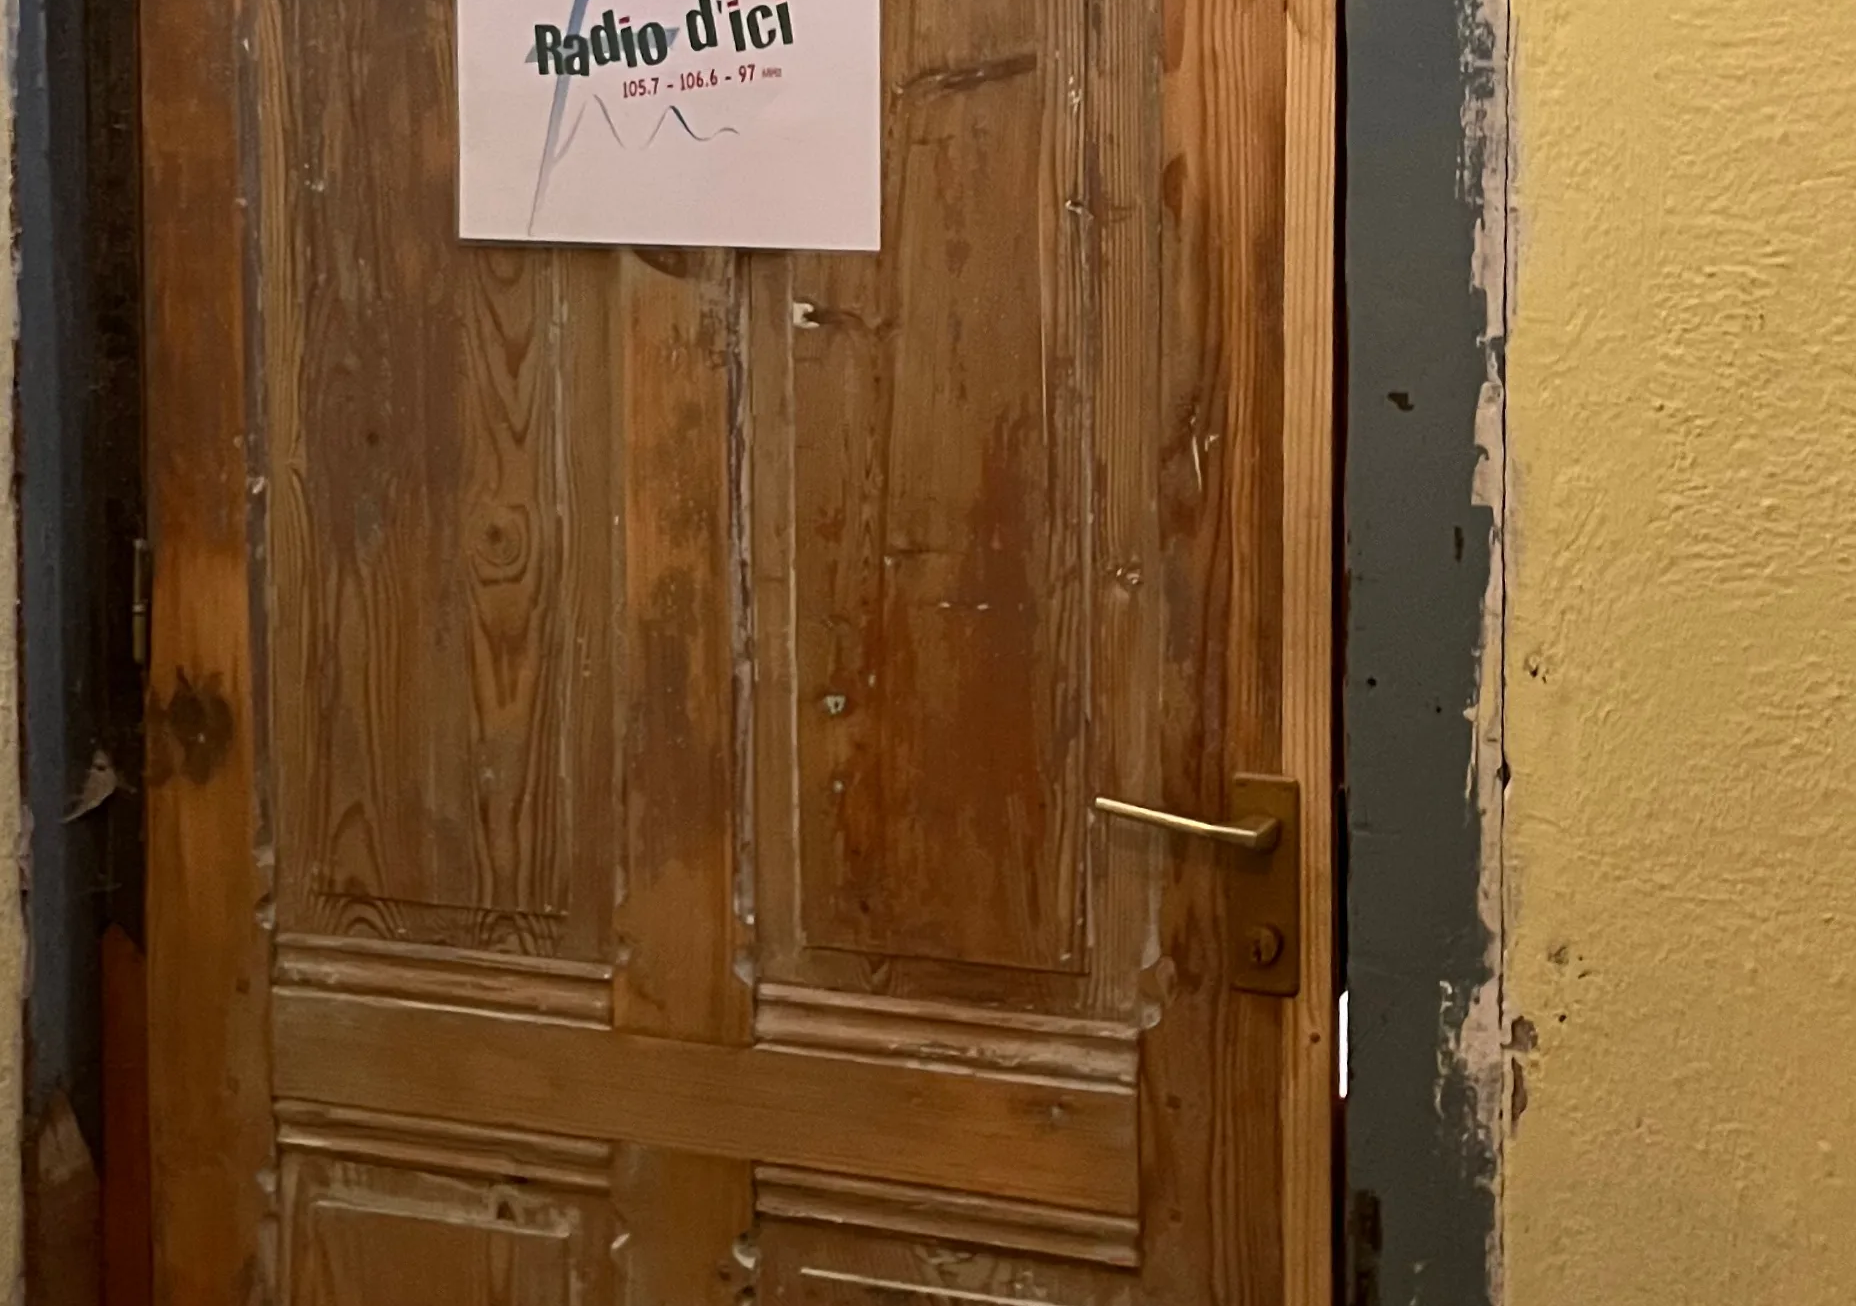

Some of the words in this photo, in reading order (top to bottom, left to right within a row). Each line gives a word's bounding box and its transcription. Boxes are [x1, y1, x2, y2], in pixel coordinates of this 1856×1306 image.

[533, 9, 668, 77] Radio
[622, 78, 660, 98] 105.7
[679, 68, 718, 92] 106.6
[738, 63, 756, 83] 97
